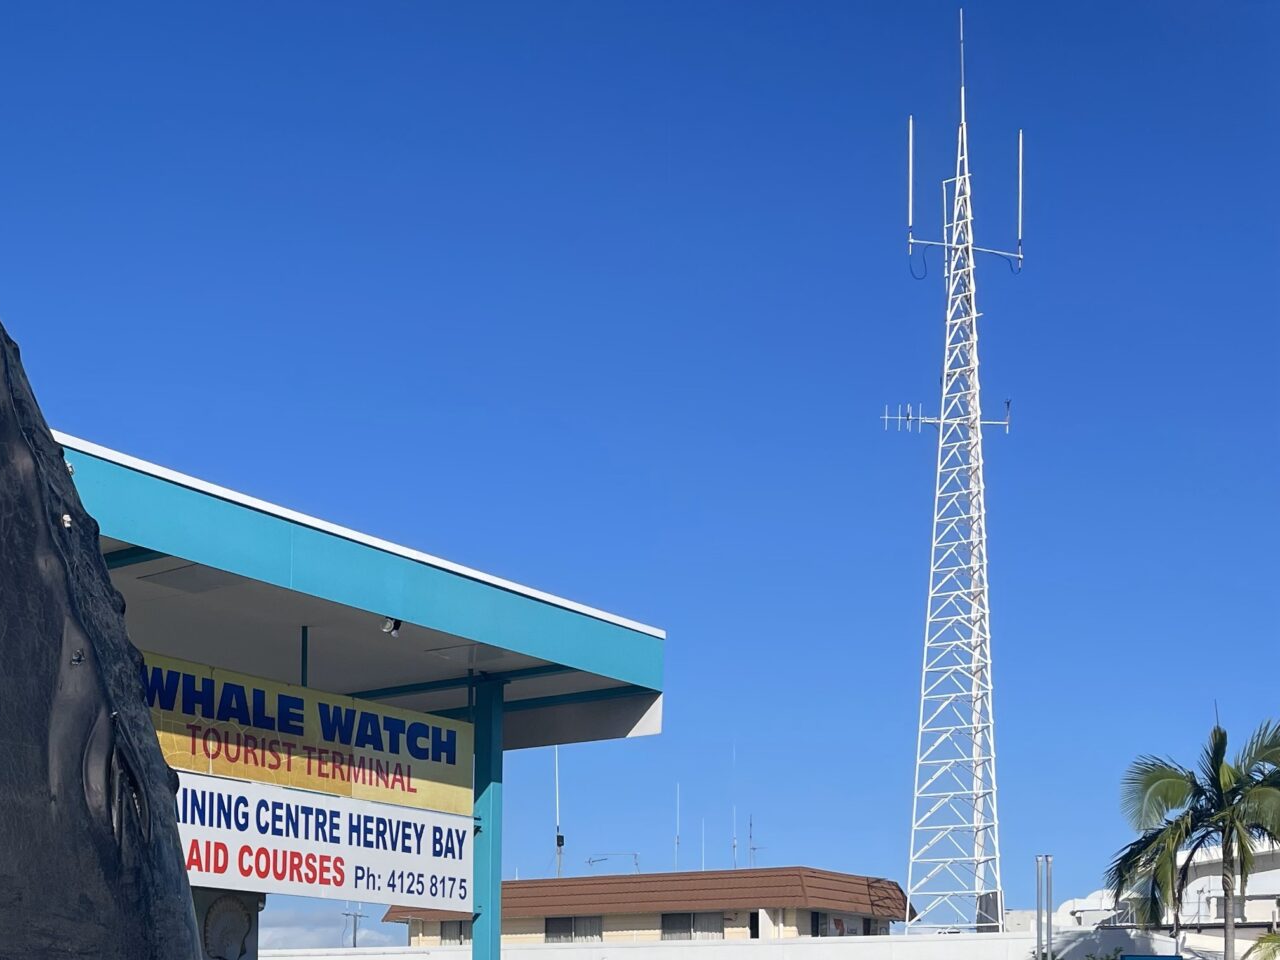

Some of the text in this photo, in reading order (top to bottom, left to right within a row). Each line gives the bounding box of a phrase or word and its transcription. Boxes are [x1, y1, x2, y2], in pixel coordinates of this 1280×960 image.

[141, 664, 457, 766] WHALE WATCH
[186, 723, 418, 794] TOURIST TERMINAL
[176, 787, 468, 860] INING CENTRE HERVEY BAY
[186, 838, 468, 900] AID COURSES Ph: 4125 8175
